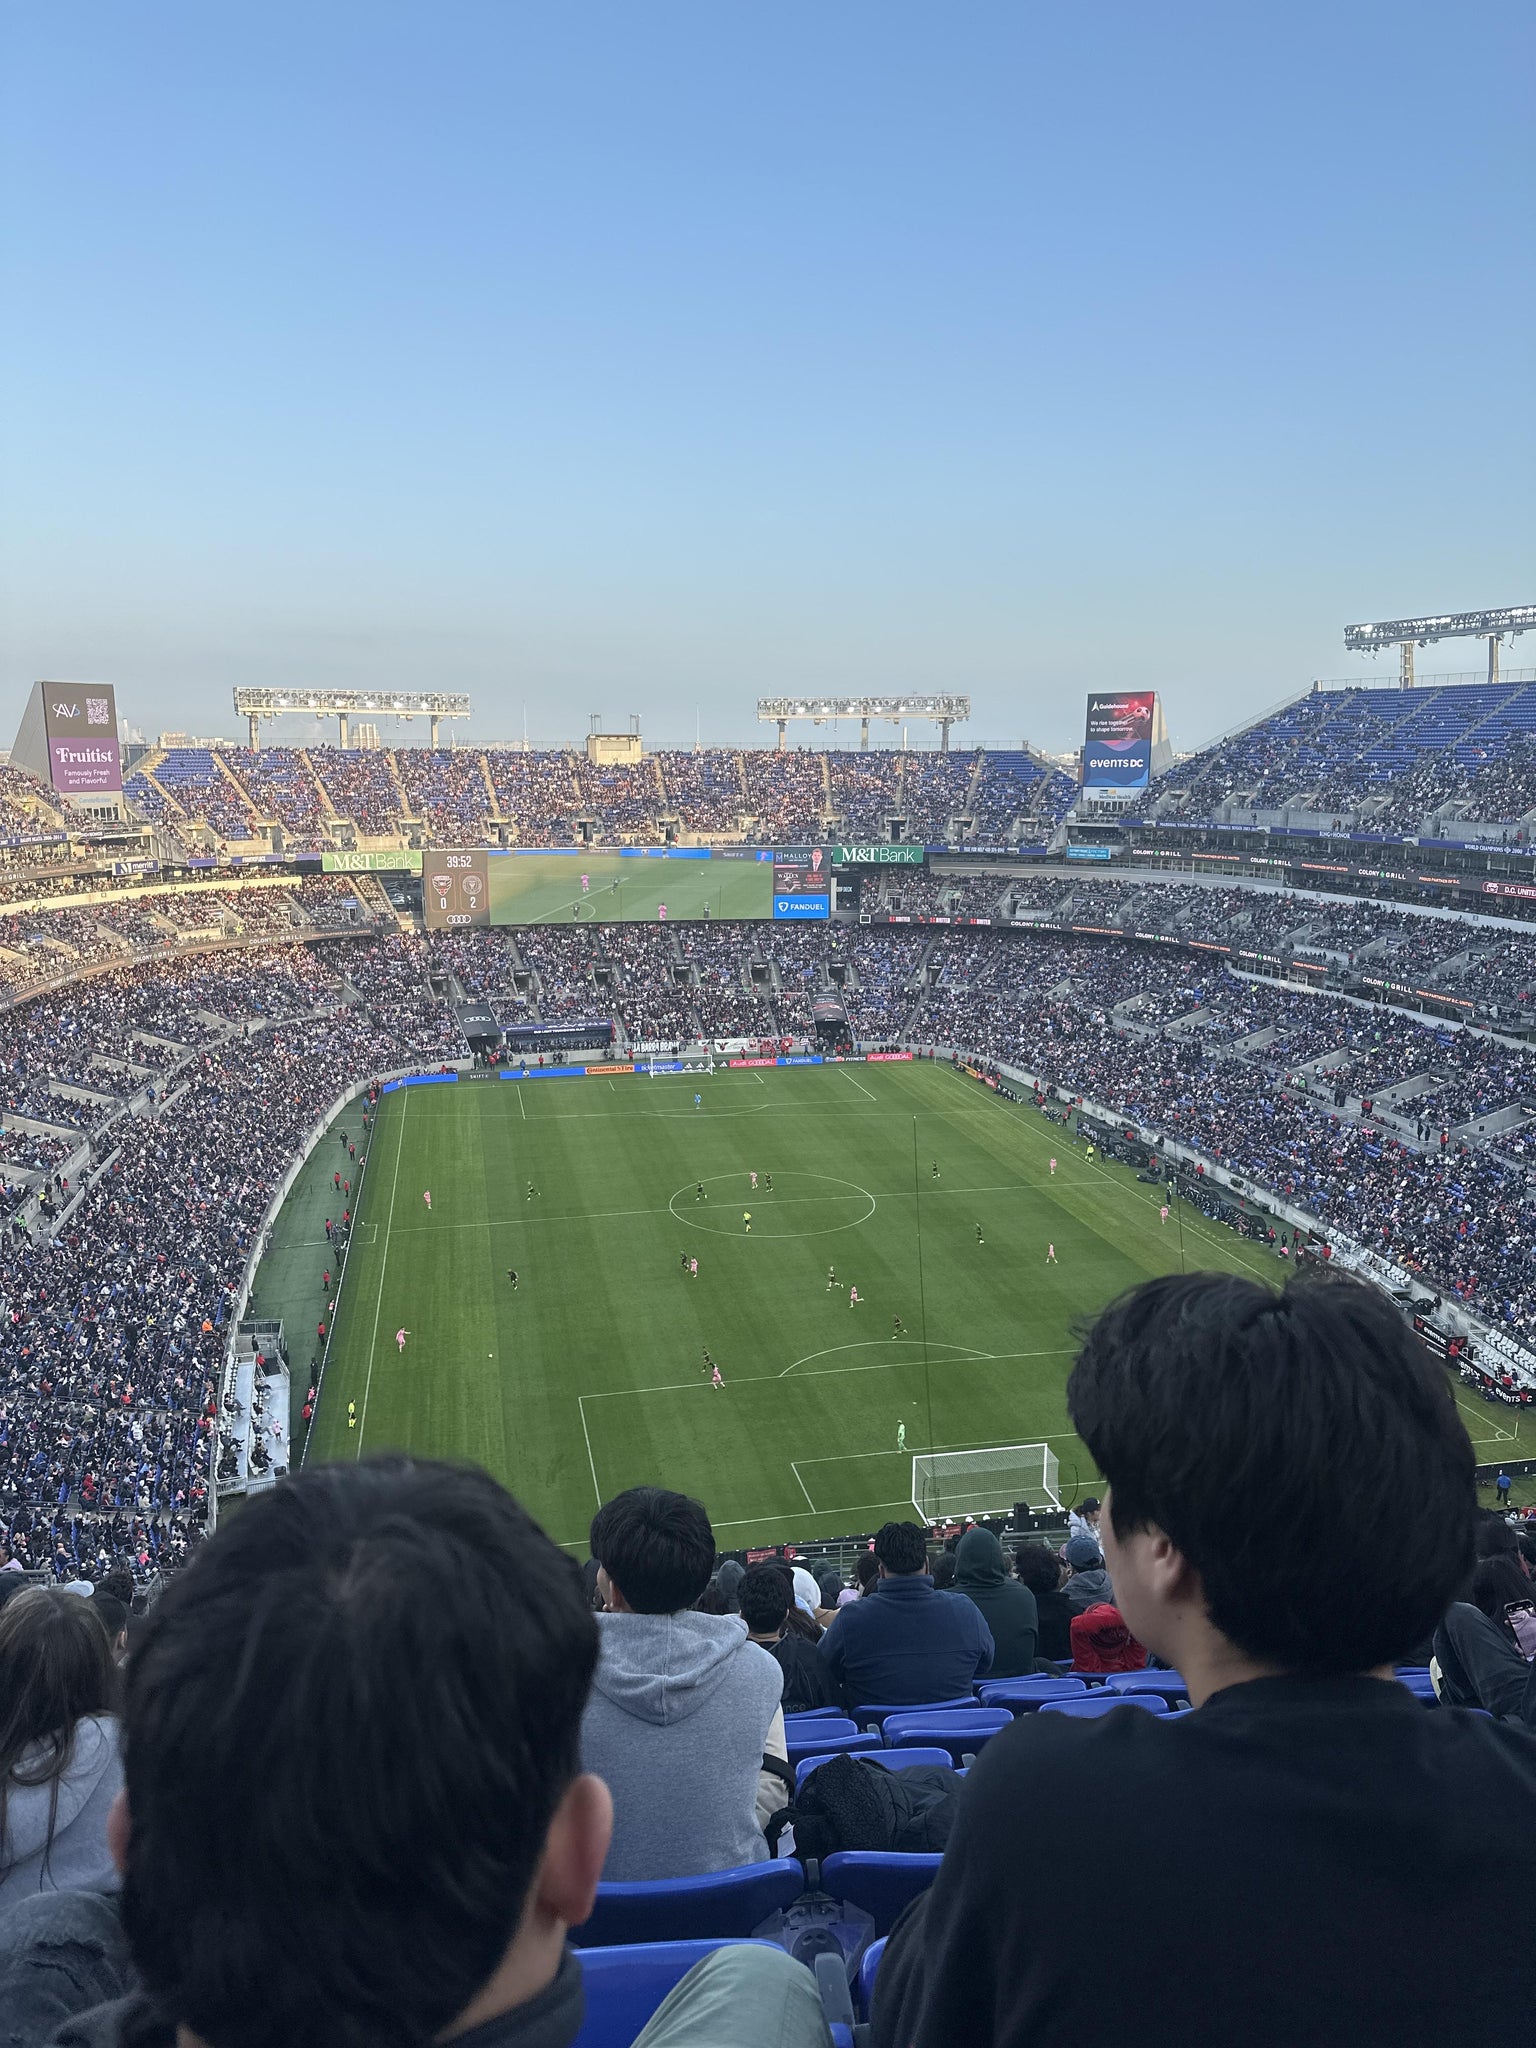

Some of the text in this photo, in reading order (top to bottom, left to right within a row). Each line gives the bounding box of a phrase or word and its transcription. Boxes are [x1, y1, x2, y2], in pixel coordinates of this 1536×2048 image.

[56, 747, 113, 763] Fruitist
[64, 769, 92, 777] Famously
[841, 848, 914, 862] M&T Bank
[133, 861, 153, 869] merritt
[333, 853, 414, 870] M&T Bank
[447, 856, 472, 868] 39:52
[1358, 869, 1406, 880] COLONY GRILL
[440, 897, 446, 909] 0
[470, 897, 476, 908] 2
[132, 954, 152, 962] COLONY
[1239, 950, 1281, 963] COLONY GRILL
[1362, 976, 1412, 994] COLONY GRILL
